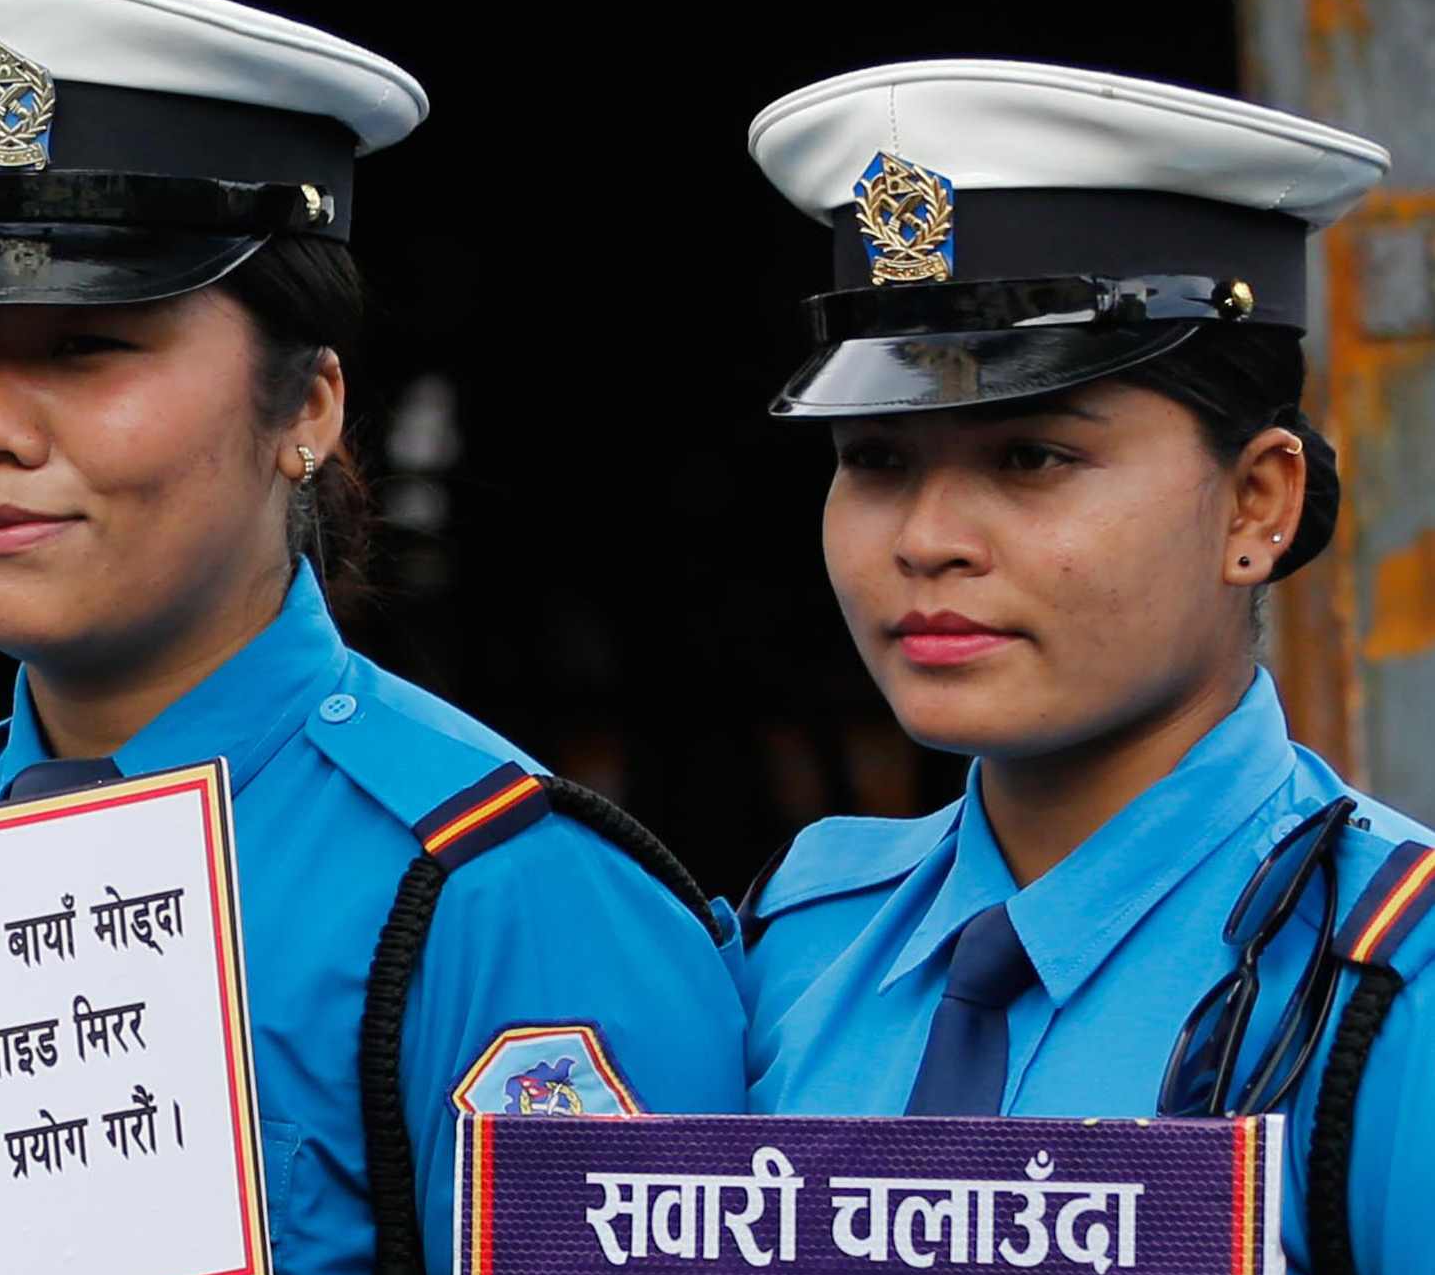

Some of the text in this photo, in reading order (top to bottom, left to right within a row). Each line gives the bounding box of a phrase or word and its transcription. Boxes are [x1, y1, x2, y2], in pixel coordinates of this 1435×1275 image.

[4, 894, 76, 968] बायाँ
[73, 995, 146, 1061] मिरर
[4, 1110, 89, 1178] प्रयोग
[585, 1146, 1145, 1275] सवारी चलाउँदा
